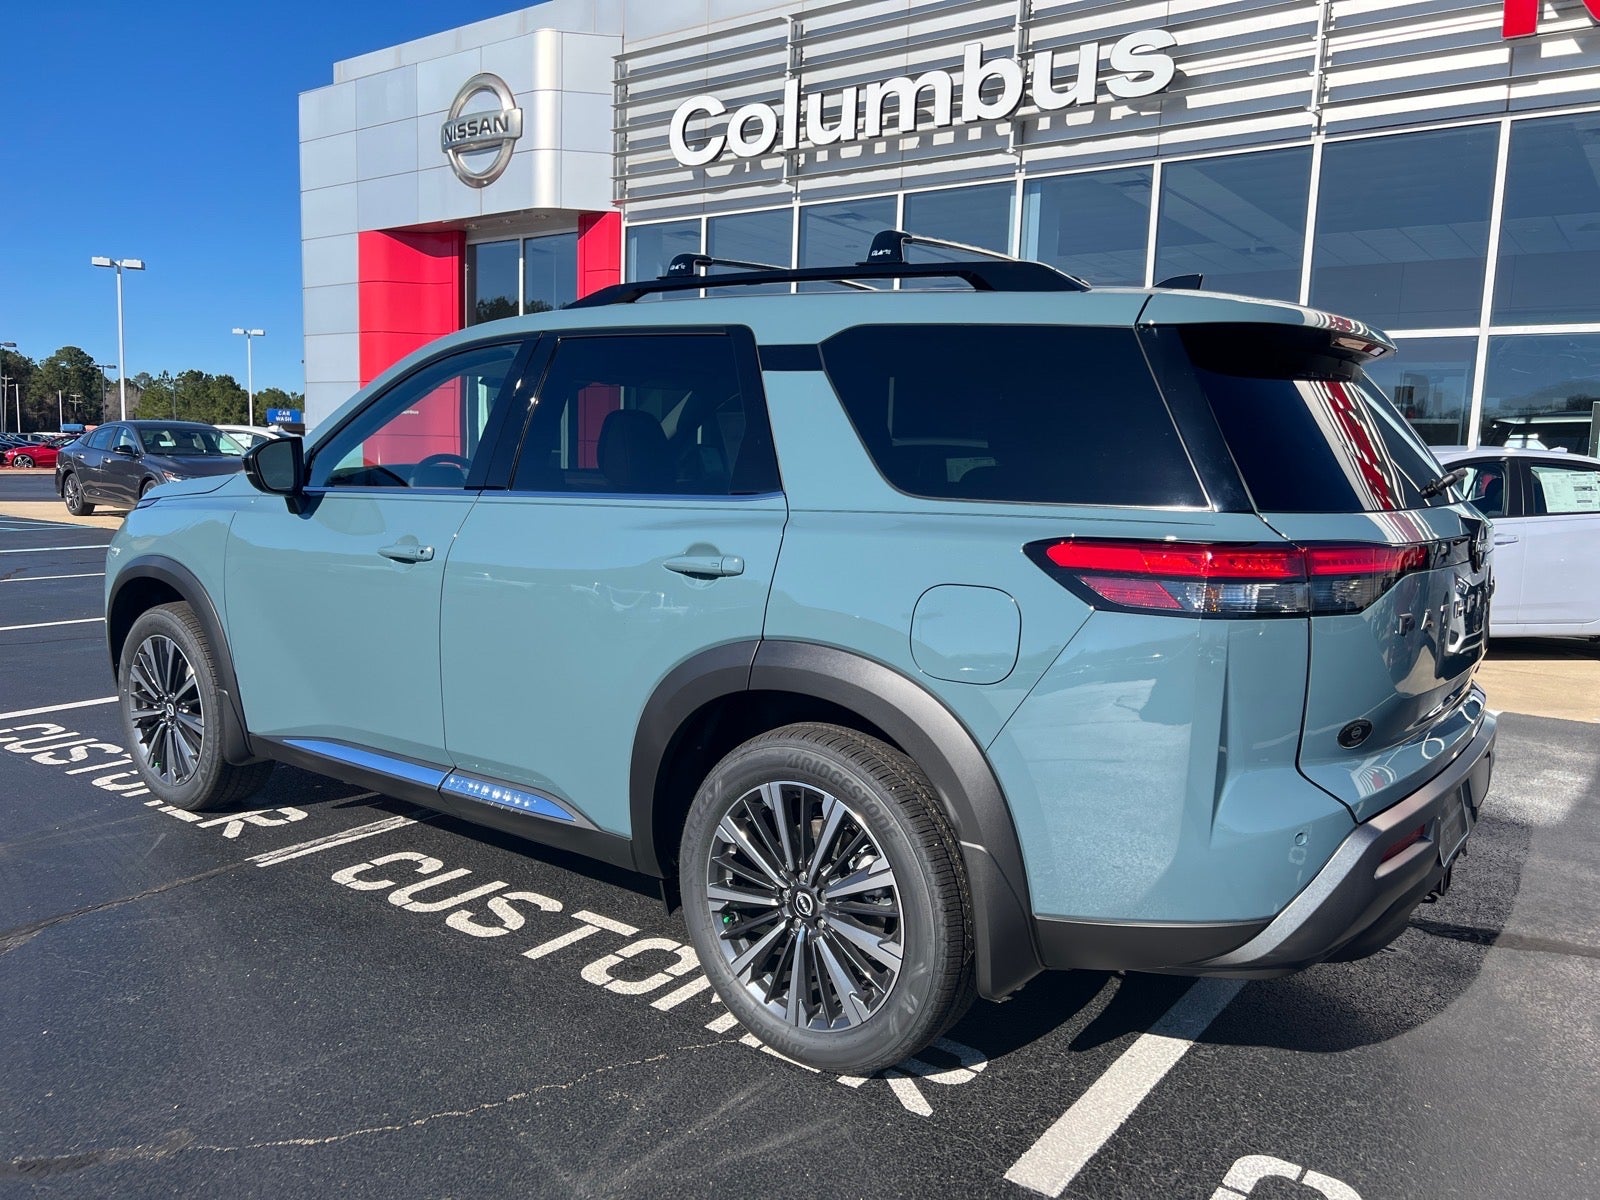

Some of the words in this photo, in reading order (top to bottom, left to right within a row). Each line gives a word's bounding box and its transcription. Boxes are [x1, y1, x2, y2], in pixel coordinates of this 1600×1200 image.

[444, 116, 509, 143] NISSAN
[669, 29, 1177, 166] Columbus
[785, 753, 899, 841] BRIDGESTONE
[331, 851, 988, 1117] CUSTOR
